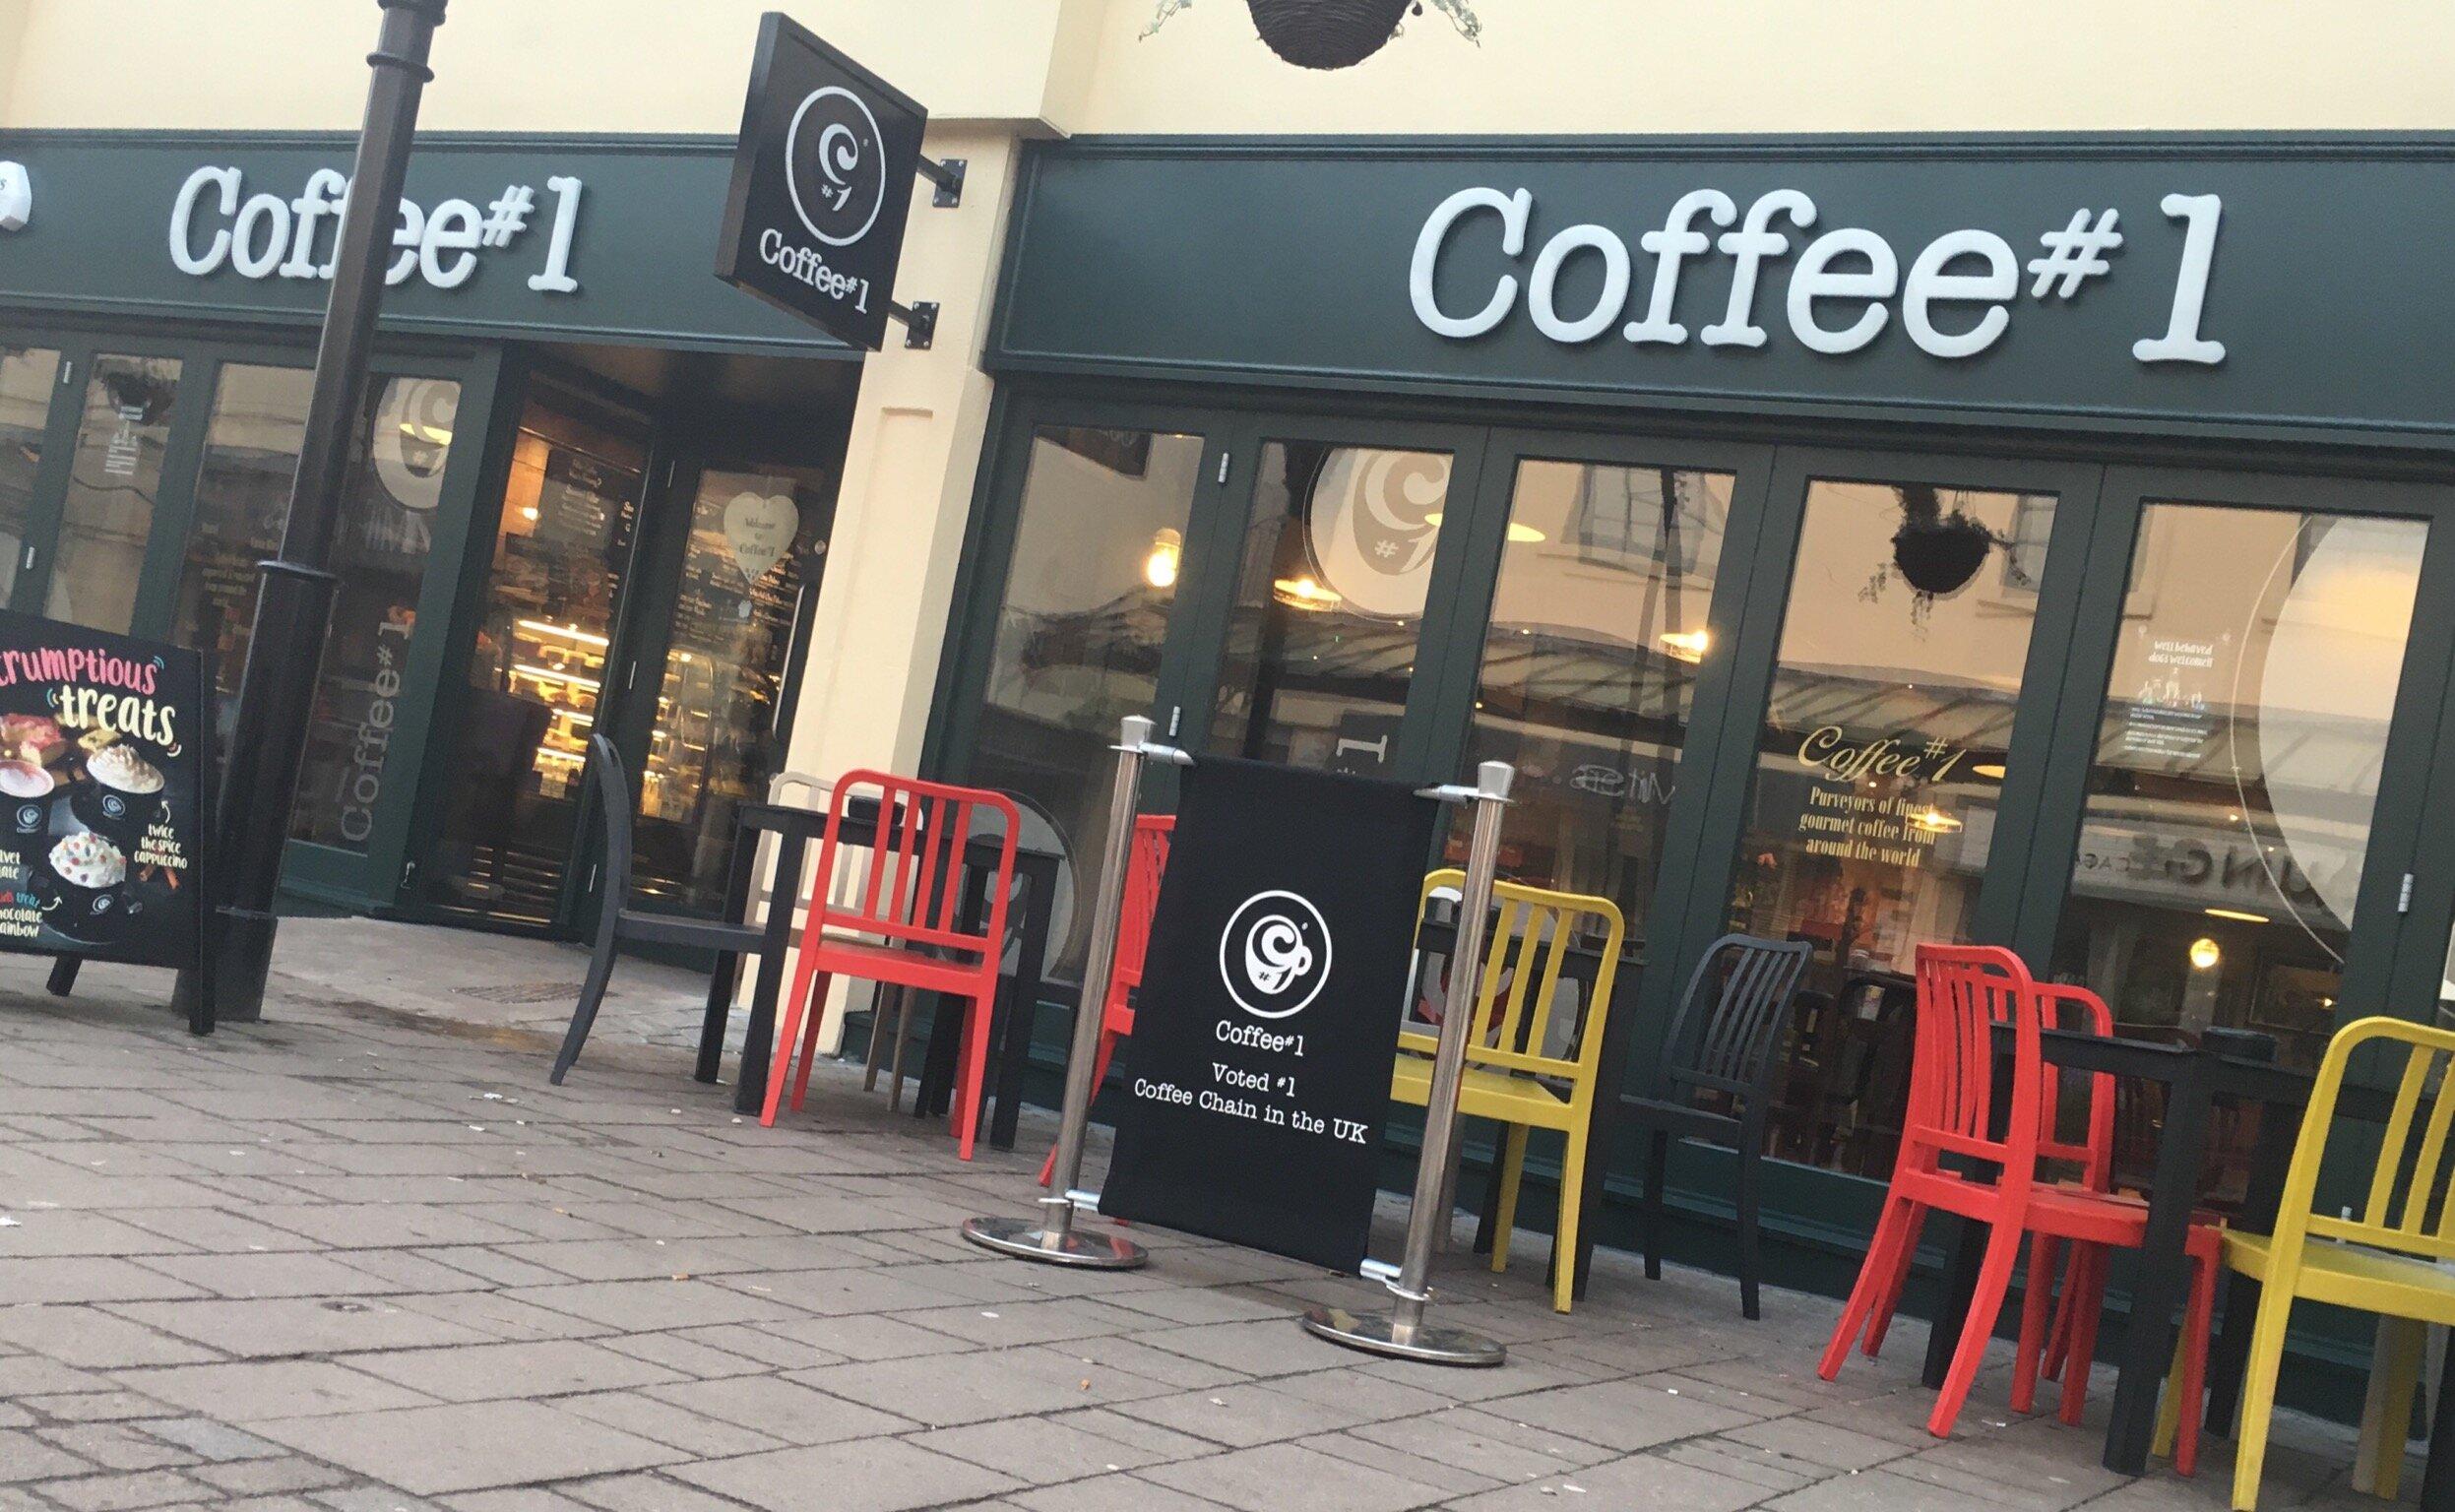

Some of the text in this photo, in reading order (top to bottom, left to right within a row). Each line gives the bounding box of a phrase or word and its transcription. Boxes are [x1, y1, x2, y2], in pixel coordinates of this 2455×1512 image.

[59, 684, 176, 746] treats
[1809, 786, 1875, 814] Purveyors
[1878, 796, 1894, 815] of
[1798, 812, 1937, 846] gourmet coffee from
[1805, 839, 1921, 868] around the world
[1212, 1062, 1295, 1098] Voted #1
[1134, 1078, 1369, 1145] Coffee Chain in the UK
